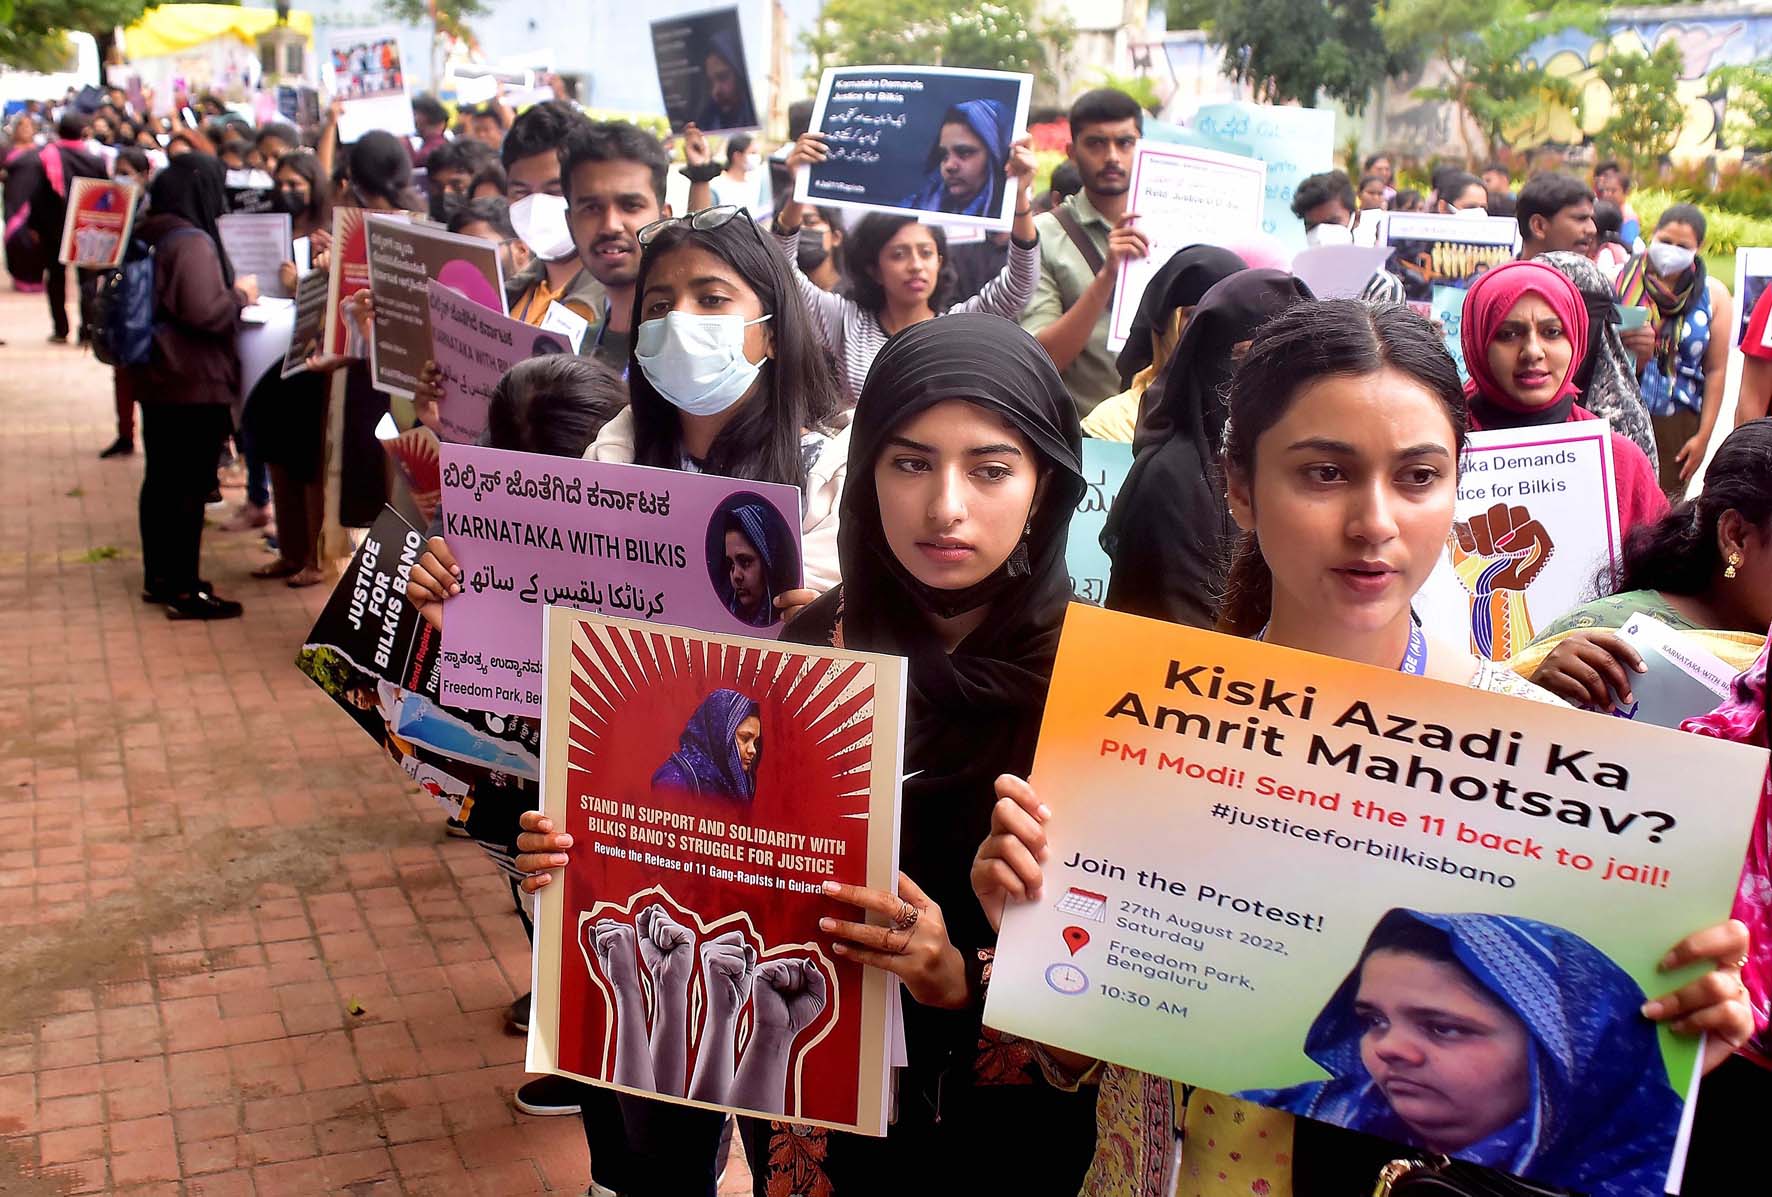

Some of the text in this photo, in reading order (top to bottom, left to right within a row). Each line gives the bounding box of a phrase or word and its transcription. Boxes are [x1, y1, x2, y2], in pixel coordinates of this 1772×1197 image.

[864, 91, 877, 101] for
[1493, 450, 1576, 470] Demands
[505, 469, 582, 505] ಜೊತೆಗಿದೆ
[587, 481, 670, 516] ಕರ್ನಾಟಕ
[1491, 483, 1513, 498] for
[1519, 478, 1566, 495] Bilkis
[446, 512, 687, 569] KARNATAKA WITH BILKIS
[347, 537, 381, 631] JUSTICE
[368, 571, 391, 618] FOR
[374, 530, 421, 669] BILKIS BANO
[470, 565, 515, 594] ساتھ
[519, 573, 539, 604] کے
[608, 582, 664, 618] کرناٹکا
[443, 680, 493, 698] Freedom
[495, 687, 523, 704] Park,
[1702, 669, 1721, 685] WITH
[1164, 659, 1630, 791] Kiski Azadi Ka
[1104, 692, 1676, 843] Amrit Mahotsav?
[580, 794, 846, 856] STAND IN SUPPORT AND SOLIDARITY WITH
[1100, 738, 1671, 888] PM Modi! Send the 11 back to jail!
[588, 816, 626, 839] BILKIS
[680, 836, 744, 862] STRUGGLE
[748, 848, 773, 866] FOR
[777, 854, 834, 875] JUSTICE
[594, 841, 626, 859] Revoke
[628, 848, 643, 863] the
[645, 853, 681, 871] Release
[683, 860, 694, 873] of
[695, 863, 706, 875] 11
[709, 866, 773, 889] Gang-Rapists
[1211, 802, 1516, 889] #justiceforbilkisbano
[1063, 852, 1325, 933] Join the Protest!
[1116, 916, 1205, 952] Saturday
[1119, 900, 1161, 921] 27th
[1166, 913, 1234, 941] August
[1106, 954, 1209, 991] Bengaluru
[1109, 940, 1197, 974] Freedom
[1100, 984, 1189, 1018] 10:30 AM
